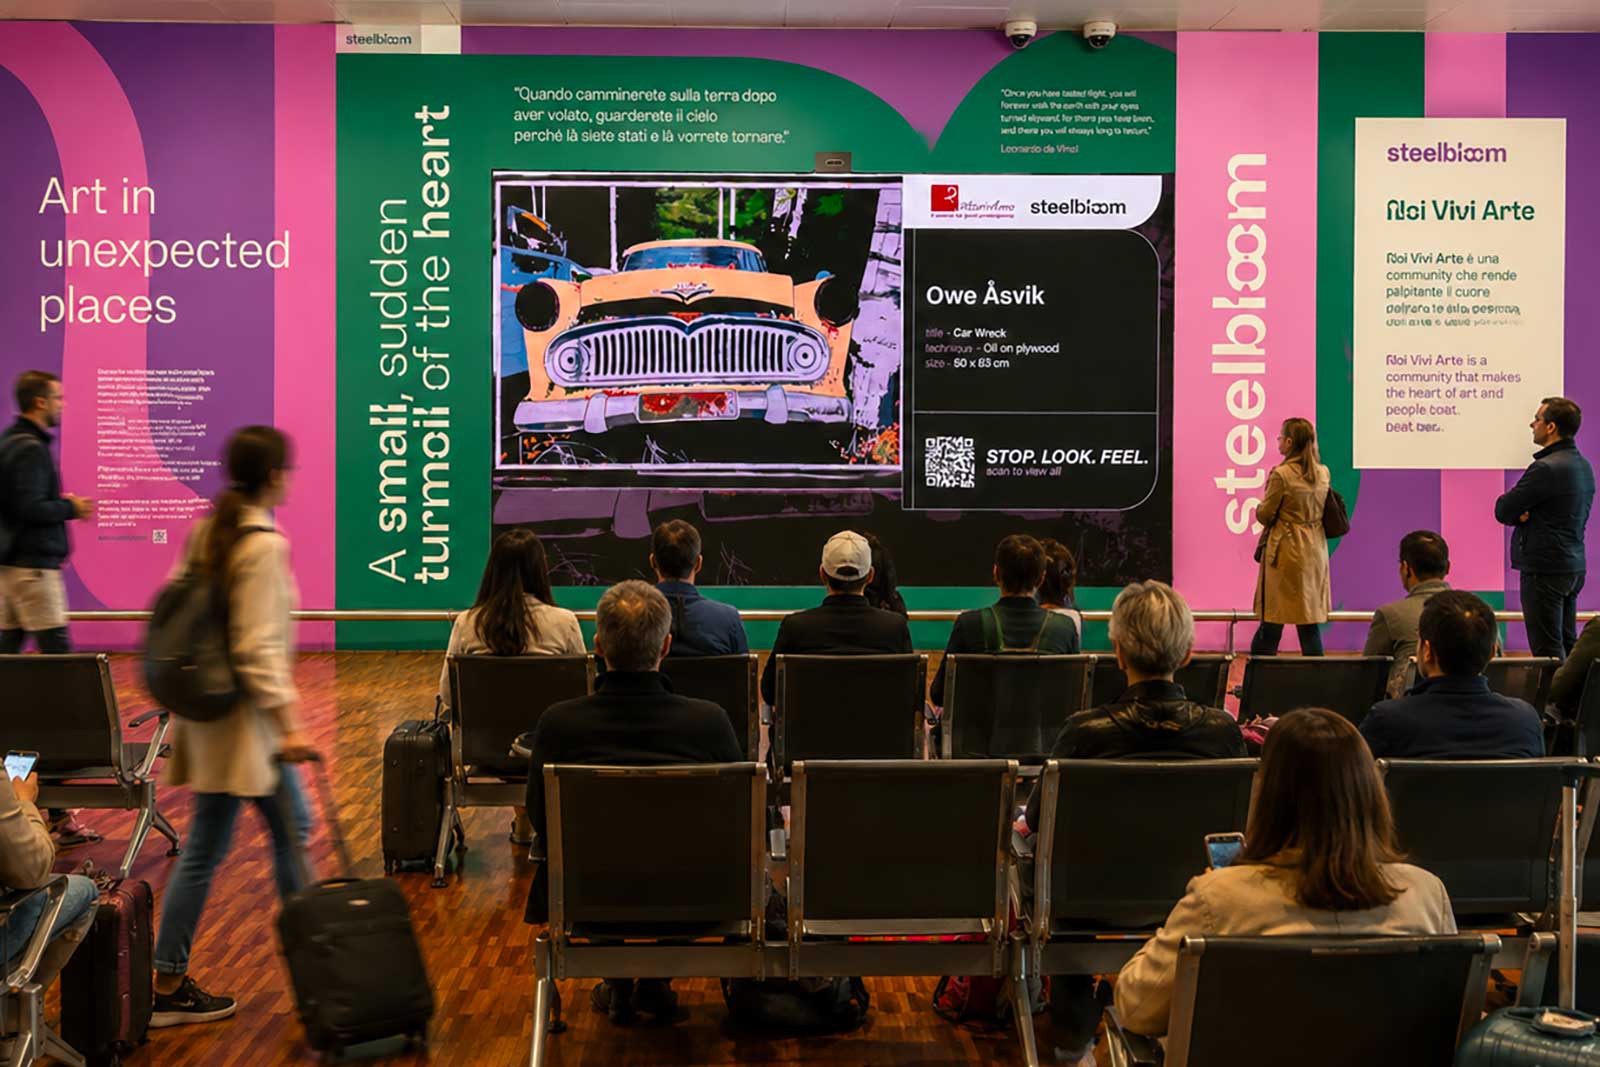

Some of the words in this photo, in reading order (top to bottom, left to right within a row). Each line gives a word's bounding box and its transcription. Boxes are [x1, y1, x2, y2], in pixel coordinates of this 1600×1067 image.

[514, 86, 573, 102] "Quando
[576, 88, 666, 101] camminerete
[670, 88, 700, 102] sulla
[704, 90, 739, 102] terra
[742, 89, 777, 104] dopo
[514, 111, 544, 121] aver
[548, 109, 593, 123] volato,
[596, 110, 673, 125] guarderete
[677, 109, 684, 121] il
[687, 110, 718, 122] cielo
[514, 129, 563, 144] perché
[567, 129, 578, 142] là
[582, 130, 614, 142] siete
[618, 129, 647, 142] stati
[651, 133, 659, 142] e
[663, 130, 674, 143] là
[678, 132, 728, 143] vorrete
[412, 105, 451, 238] heart
[39, 177, 107, 215] Art
[122, 177, 156, 215] in
[1432, 200, 1476, 221] Vivi
[1482, 200, 1535, 221] Arte
[40, 230, 290, 277] unexpected
[1411, 253, 1433, 265] Vivi
[1435, 253, 1464, 265] Arte
[1478, 255, 1499, 264] una
[1386, 270, 1452, 283] community
[1456, 270, 1478, 281] che
[1482, 270, 1518, 281] rende
[370, 199, 408, 376] sudden
[412, 256, 451, 332] the
[926, 286, 978, 305] Owe
[983, 280, 1045, 305] Åsvik
[1386, 286, 1443, 299] palpitante
[1455, 288, 1491, 298] cuore
[40, 285, 177, 332] places
[953, 328, 973, 338] Car
[975, 328, 1007, 338] Wreck
[983, 343, 998, 353] Oil
[1000, 345, 1014, 353] on
[1015, 343, 1060, 356] plywood
[412, 346, 451, 390] of
[969, 360, 977, 368] x
[993, 360, 1010, 368] cm
[1410, 355, 1433, 366] Vivi
[1435, 355, 1464, 366] Arte
[1467, 355, 1477, 366] is
[1480, 357, 1488, 366] a
[1386, 371, 1452, 384] community
[1455, 371, 1479, 382] that
[1482, 371, 1522, 382] makes
[1386, 387, 1406, 399] the
[1409, 387, 1441, 399] heart
[1445, 387, 1456, 399] of
[1459, 387, 1477, 399] art
[1481, 387, 1504, 399] and
[1386, 403, 1426, 417] people
[370, 393, 414, 533] small,
[986, 449, 1037, 465] STOP.
[1041, 449, 1096, 465] LOOK.
[1100, 449, 1149, 465] FEEL.
[986, 467, 1010, 477] scan
[1013, 467, 1023, 477] to
[1025, 467, 1048, 477] view
[1049, 467, 1062, 477] all
[413, 406, 450, 584] turmoil
[369, 549, 407, 583] A
